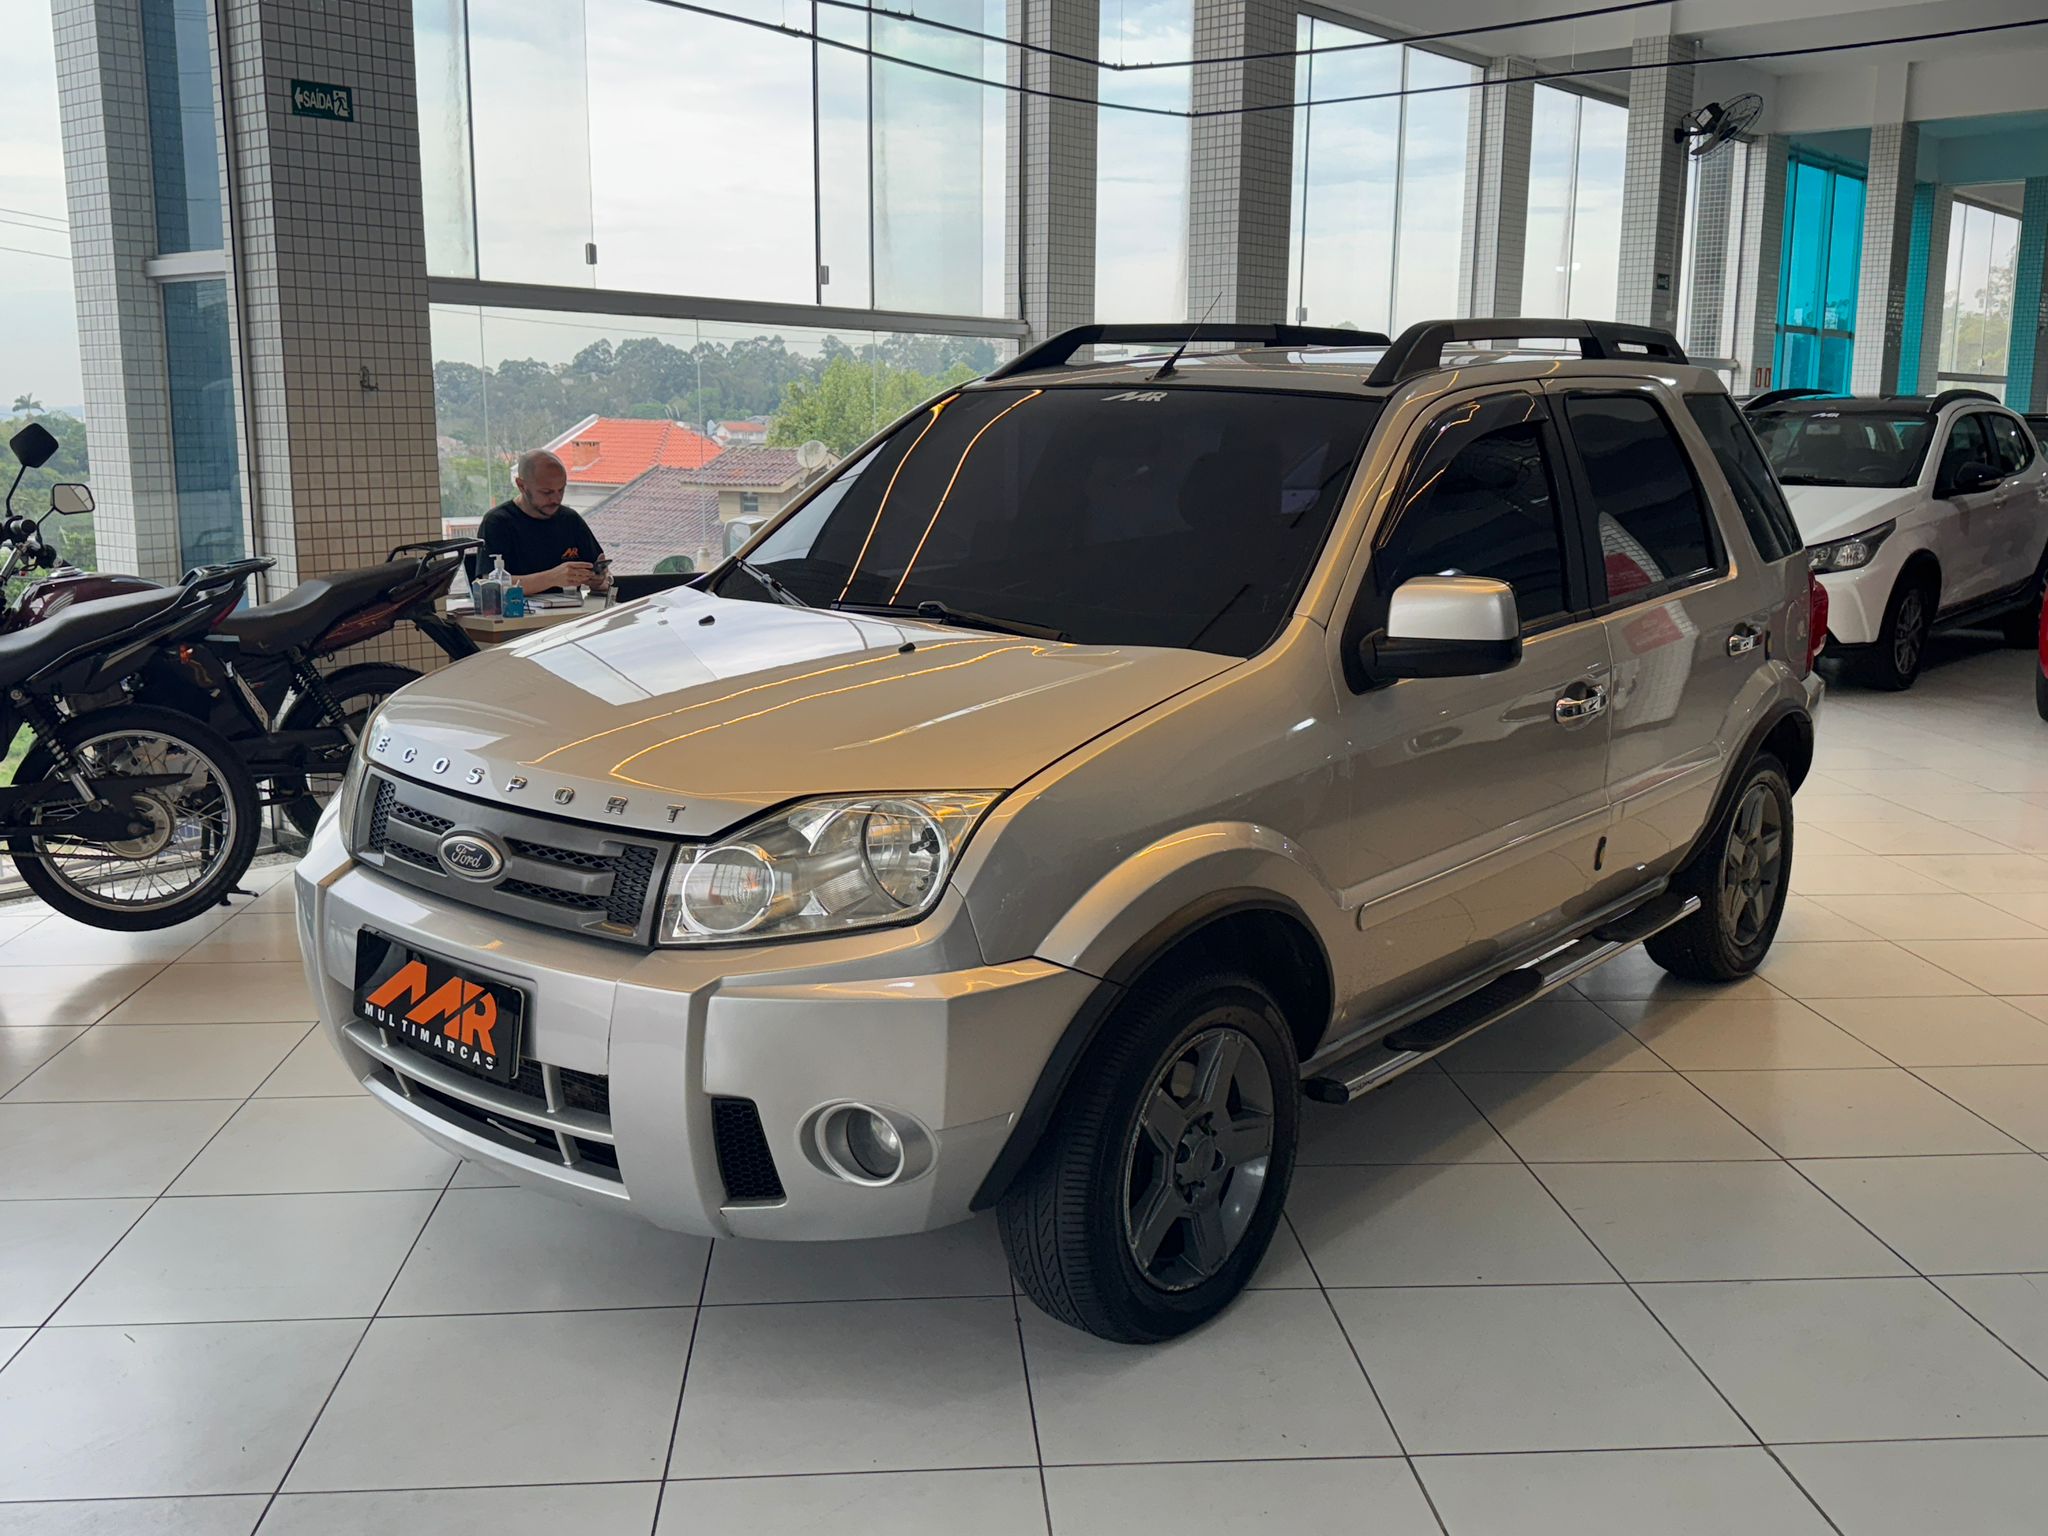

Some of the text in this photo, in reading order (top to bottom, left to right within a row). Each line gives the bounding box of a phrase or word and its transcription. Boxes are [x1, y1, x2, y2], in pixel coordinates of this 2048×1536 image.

[303, 87, 333, 111] SAÍDA
[376, 735, 687, 823] ECOSPORT
[450, 843, 483, 869] Ford
[364, 1002, 495, 1071] MULTIMARCAS
